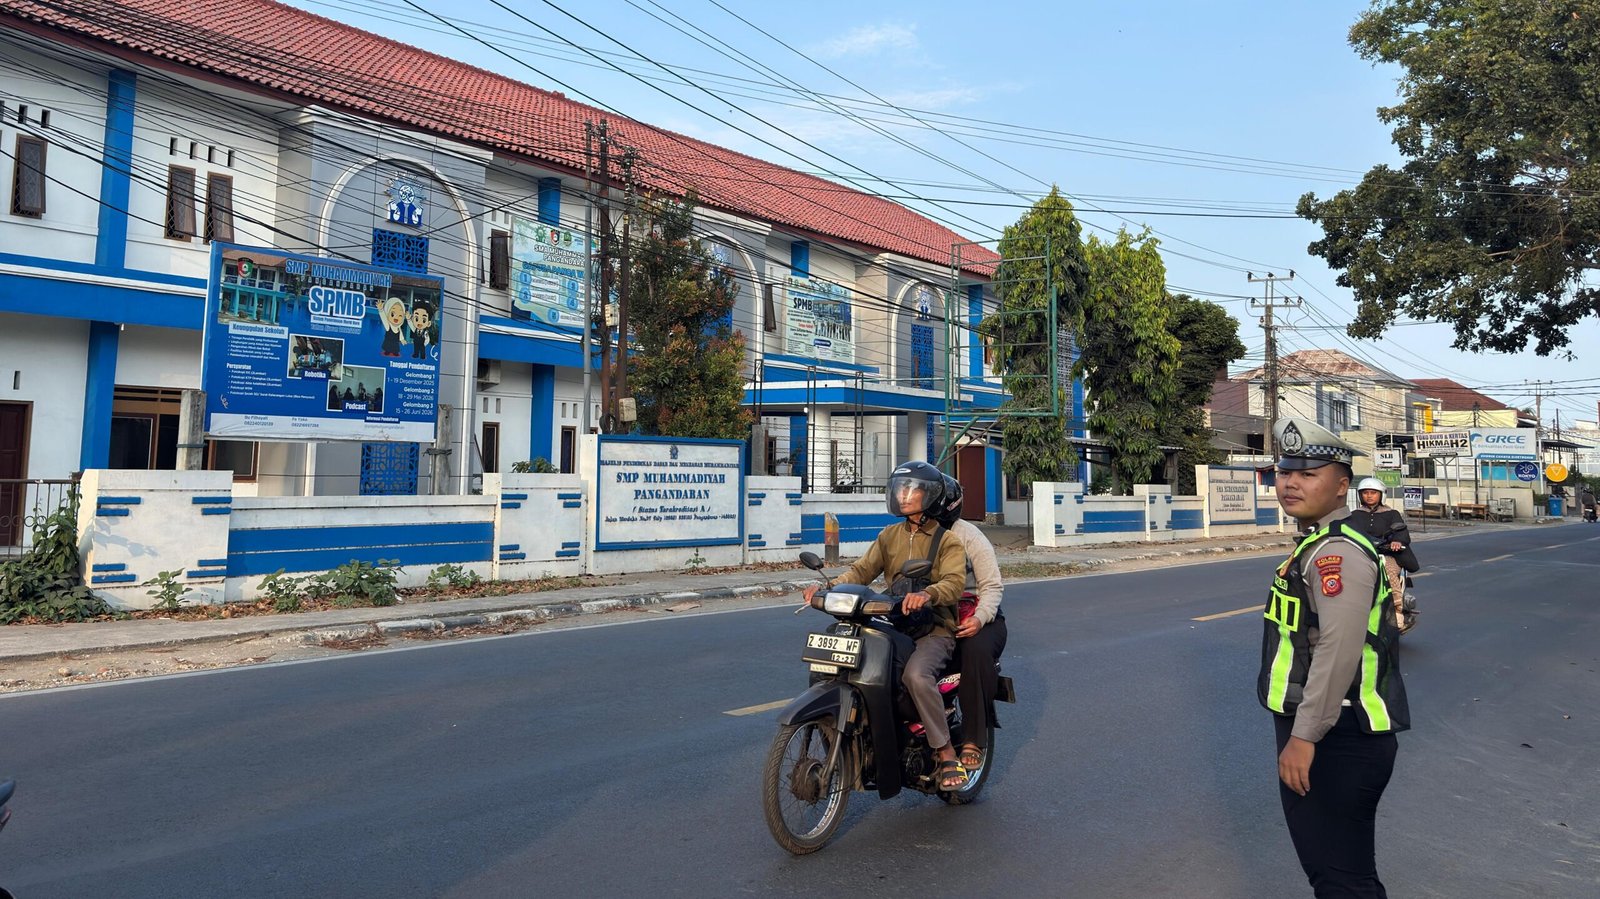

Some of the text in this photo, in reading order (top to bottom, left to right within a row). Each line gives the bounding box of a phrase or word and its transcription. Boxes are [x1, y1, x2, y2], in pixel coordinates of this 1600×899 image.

[544, 254, 585, 266] PANGANDARA
[286, 260, 392, 288] SMP MUHAMMADIYAH
[310, 287, 365, 318] SPMB
[794, 297, 812, 310] SPMB
[265, 326, 284, 335] Sekolah
[1486, 435, 1526, 444] GREE
[616, 472, 726, 484] SMP MUHAMMADIYAH
[634, 489, 710, 500] PANGANDARAN
[1317, 556, 1340, 565] POLRES
[809, 636, 858, 651] Z 3892 WF
